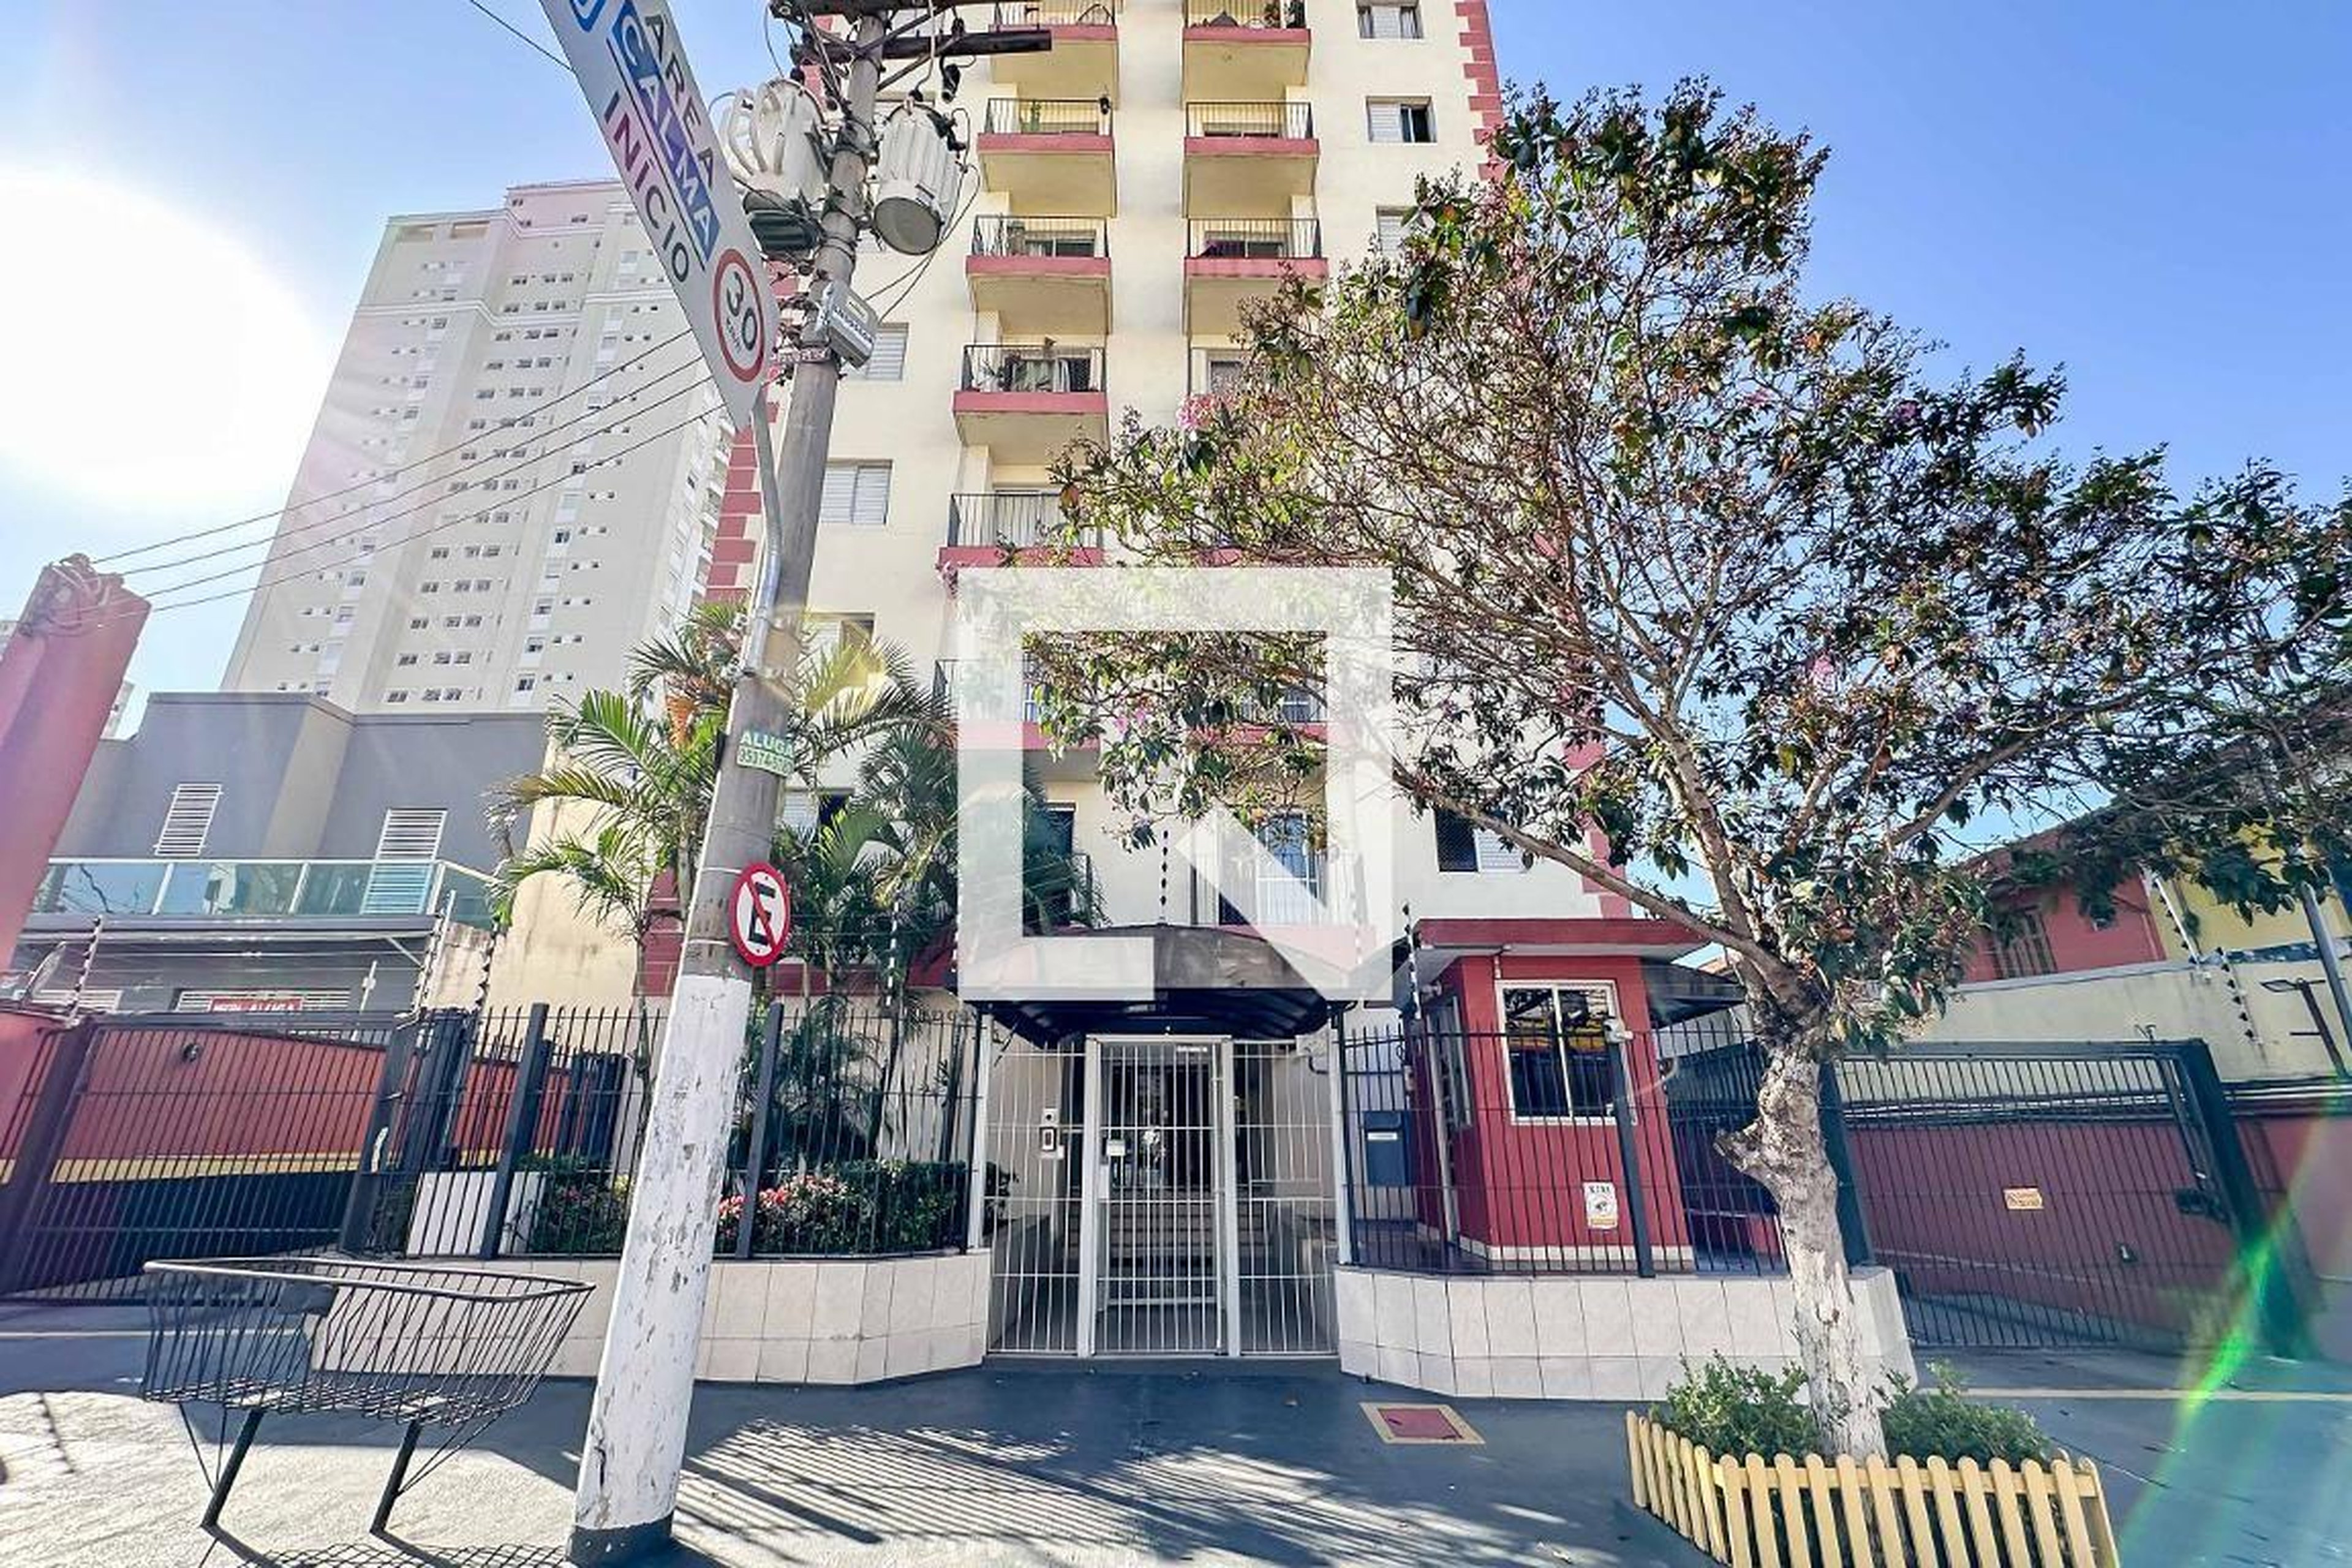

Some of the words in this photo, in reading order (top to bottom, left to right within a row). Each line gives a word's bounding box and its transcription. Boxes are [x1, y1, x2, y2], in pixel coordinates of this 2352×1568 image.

[604, 91, 690, 283] INÍCIO
[622, 15, 711, 244] CALMA
[726, 271, 758, 351] 30
[739, 729, 794, 760] ALUGA
